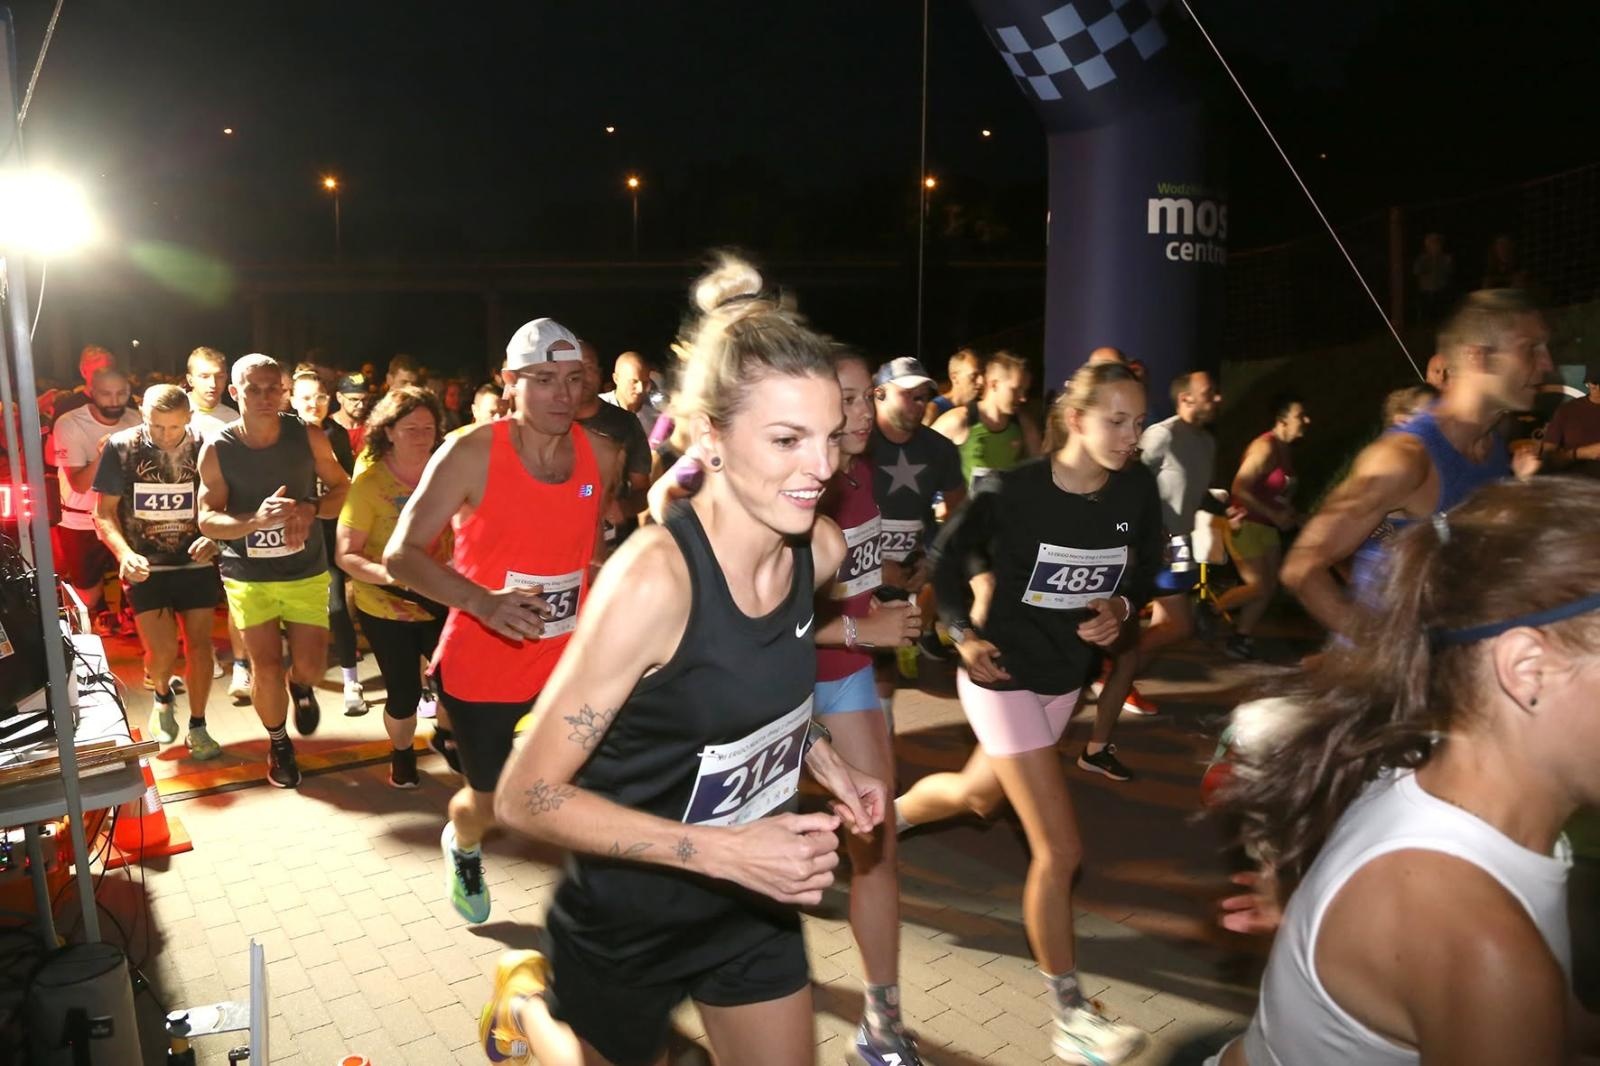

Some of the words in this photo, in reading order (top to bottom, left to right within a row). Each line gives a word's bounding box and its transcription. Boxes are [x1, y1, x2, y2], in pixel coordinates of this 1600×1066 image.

[144, 494, 185, 510] 419
[881, 532, 917, 550] 225
[1046, 566, 1108, 592] 485
[541, 591, 571, 619] 65
[711, 735, 793, 815] 212
